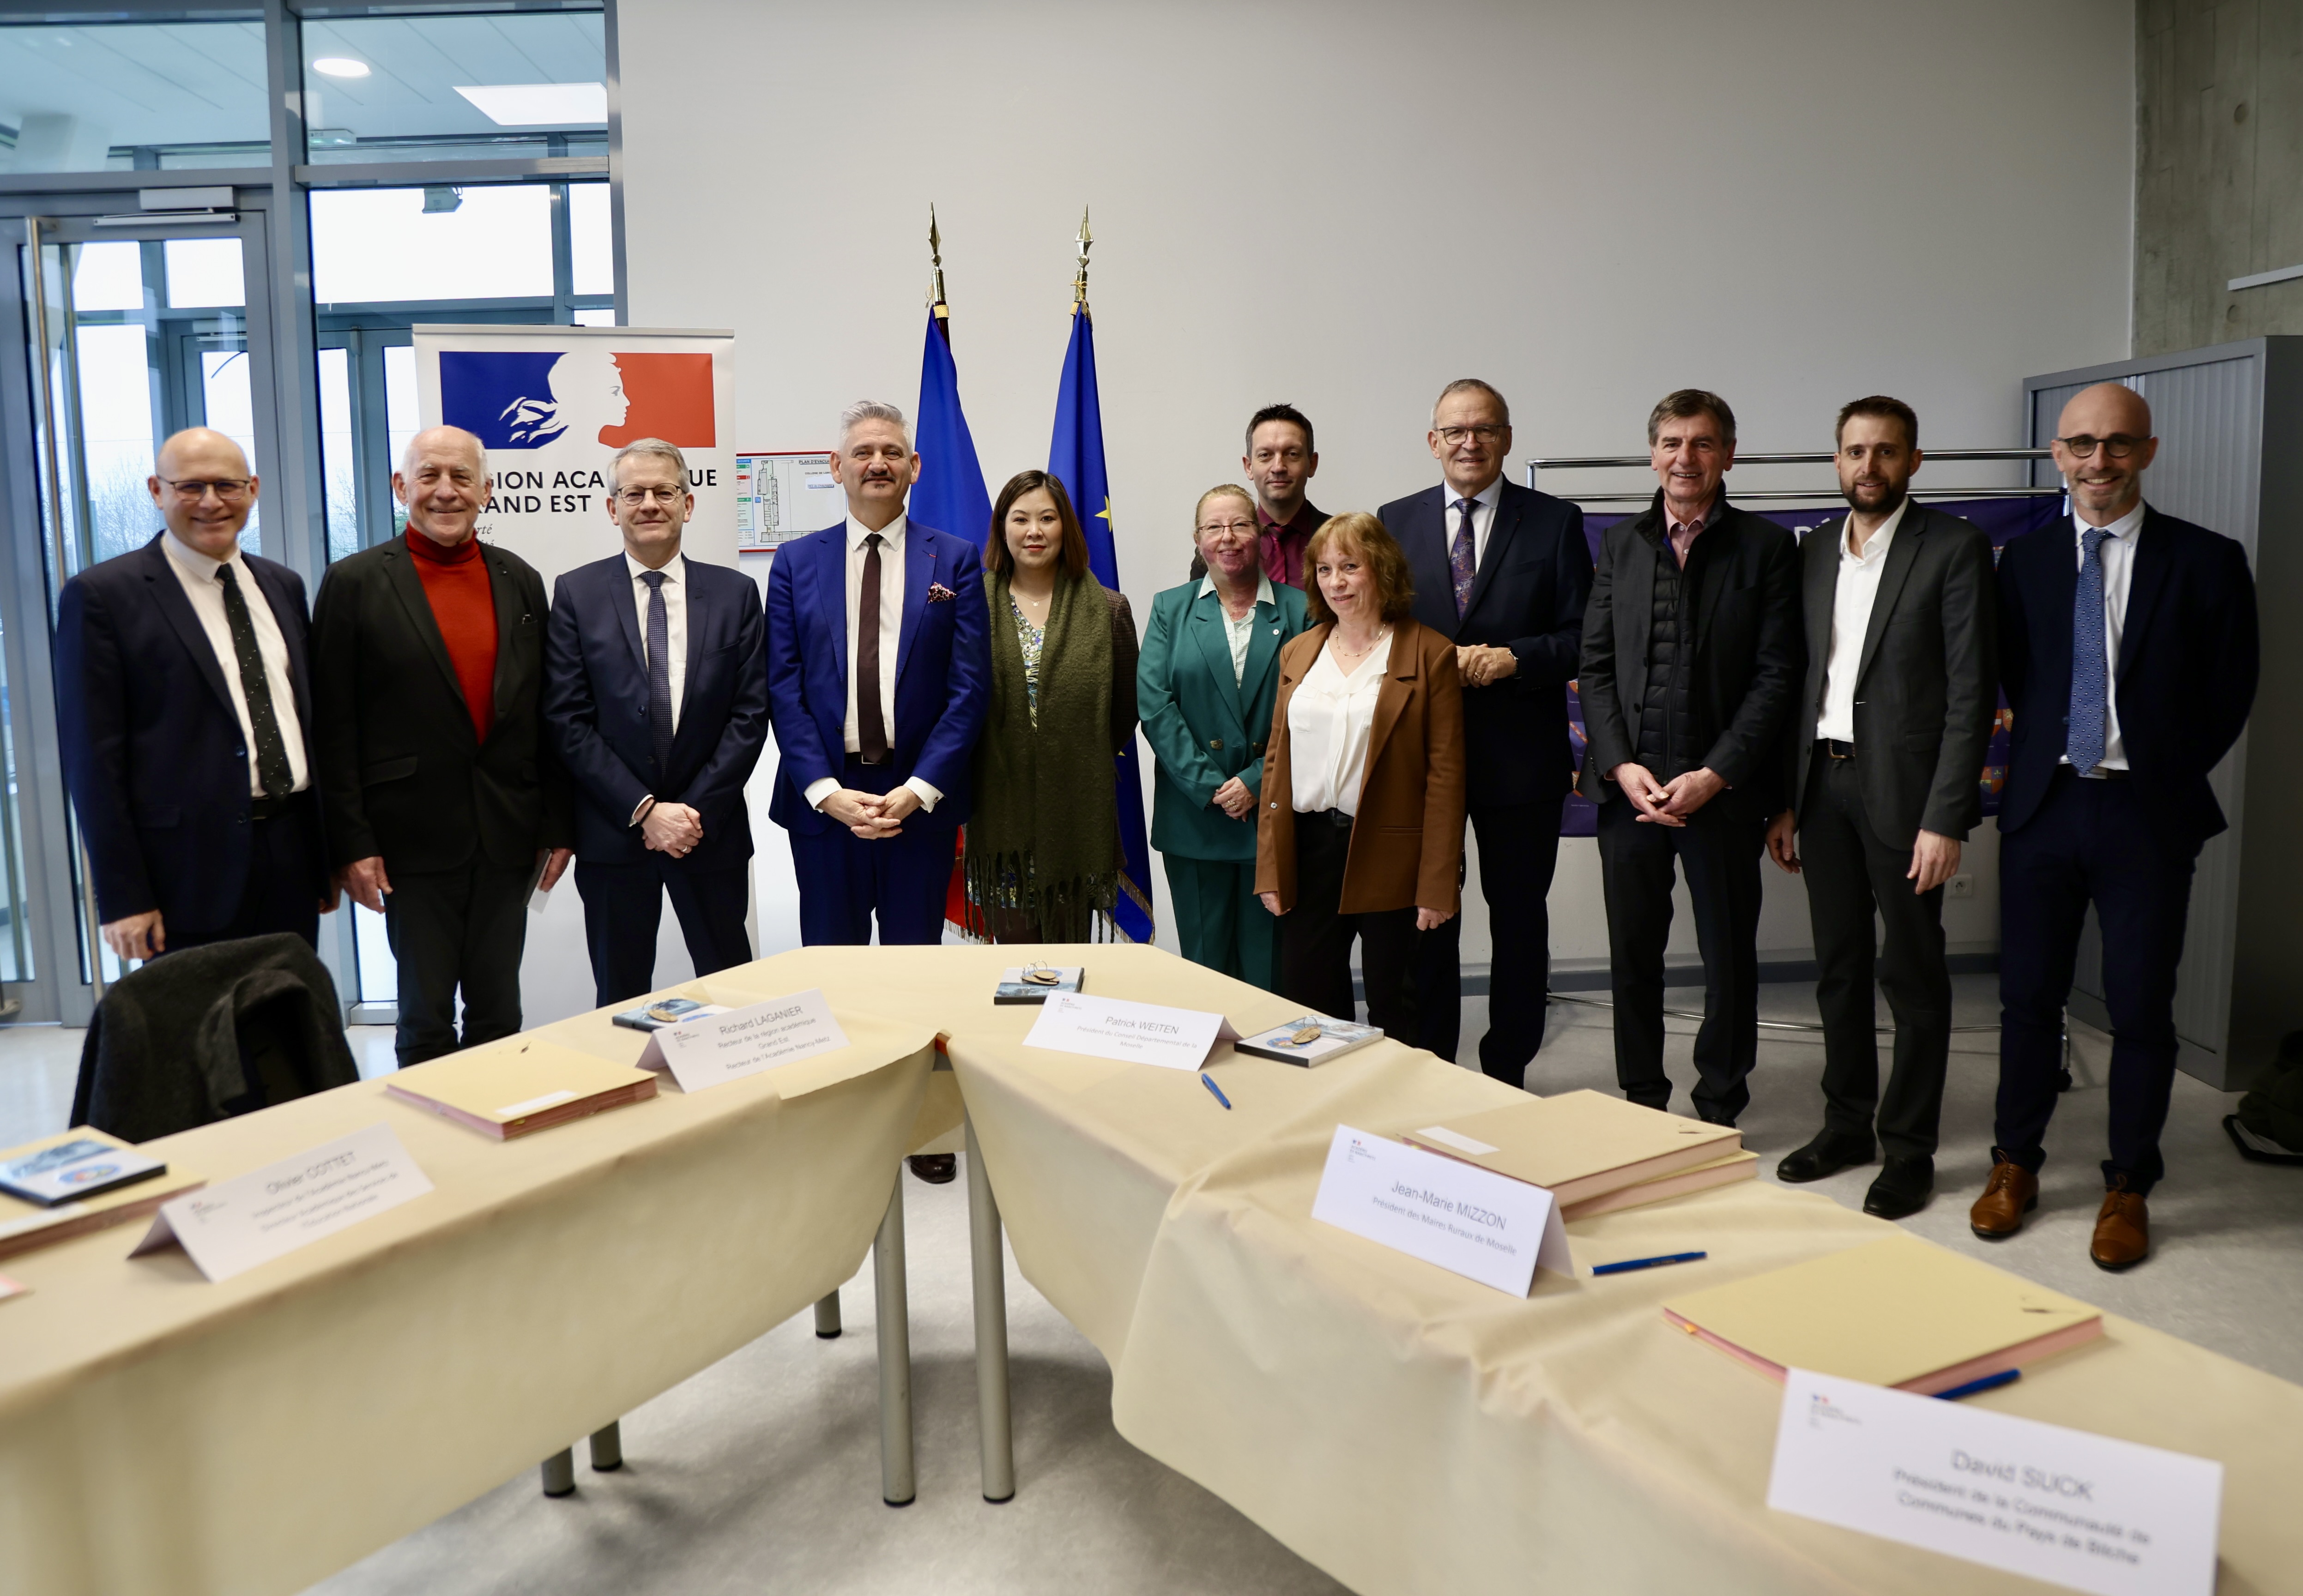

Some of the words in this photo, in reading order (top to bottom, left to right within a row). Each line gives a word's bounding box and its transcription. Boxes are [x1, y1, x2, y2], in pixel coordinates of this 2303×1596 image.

[478, 495, 541, 514] AND
[550, 495, 592, 512] EST
[718, 1038, 743, 1048] Recteur
[760, 1029, 780, 1037] région
[780, 1018, 816, 1032] académique
[719, 1018, 755, 1035] Richard
[754, 1006, 804, 1026] LAGANIER
[1105, 1016, 1136, 1028] Patrick
[1139, 1021, 1180, 1035] WEITEN
[758, 1039, 778, 1049] Grand
[1076, 1025, 1104, 1035] Président
[1114, 1031, 1136, 1040] Conseil
[1136, 1035, 1181, 1047] Départemental
[1119, 1041, 1143, 1050] Moselle
[726, 1059, 751, 1070] Recteur
[265, 1174, 304, 1196] Olivier
[305, 1150, 356, 1180] COTTET
[1391, 1180, 1454, 1212] Jean-Marie
[1457, 1201, 1507, 1231] MIZZON
[1373, 1196, 1406, 1216] Président
[1407, 1210, 1420, 1221] des
[1422, 1214, 1446, 1231] Maires
[1448, 1223, 1474, 1241] Ruraux
[1475, 1234, 1485, 1244] de
[1487, 1237, 1517, 1256] Moselle
[1951, 1449, 2017, 1483] David
[2021, 1465, 2096, 1503] SUCK
